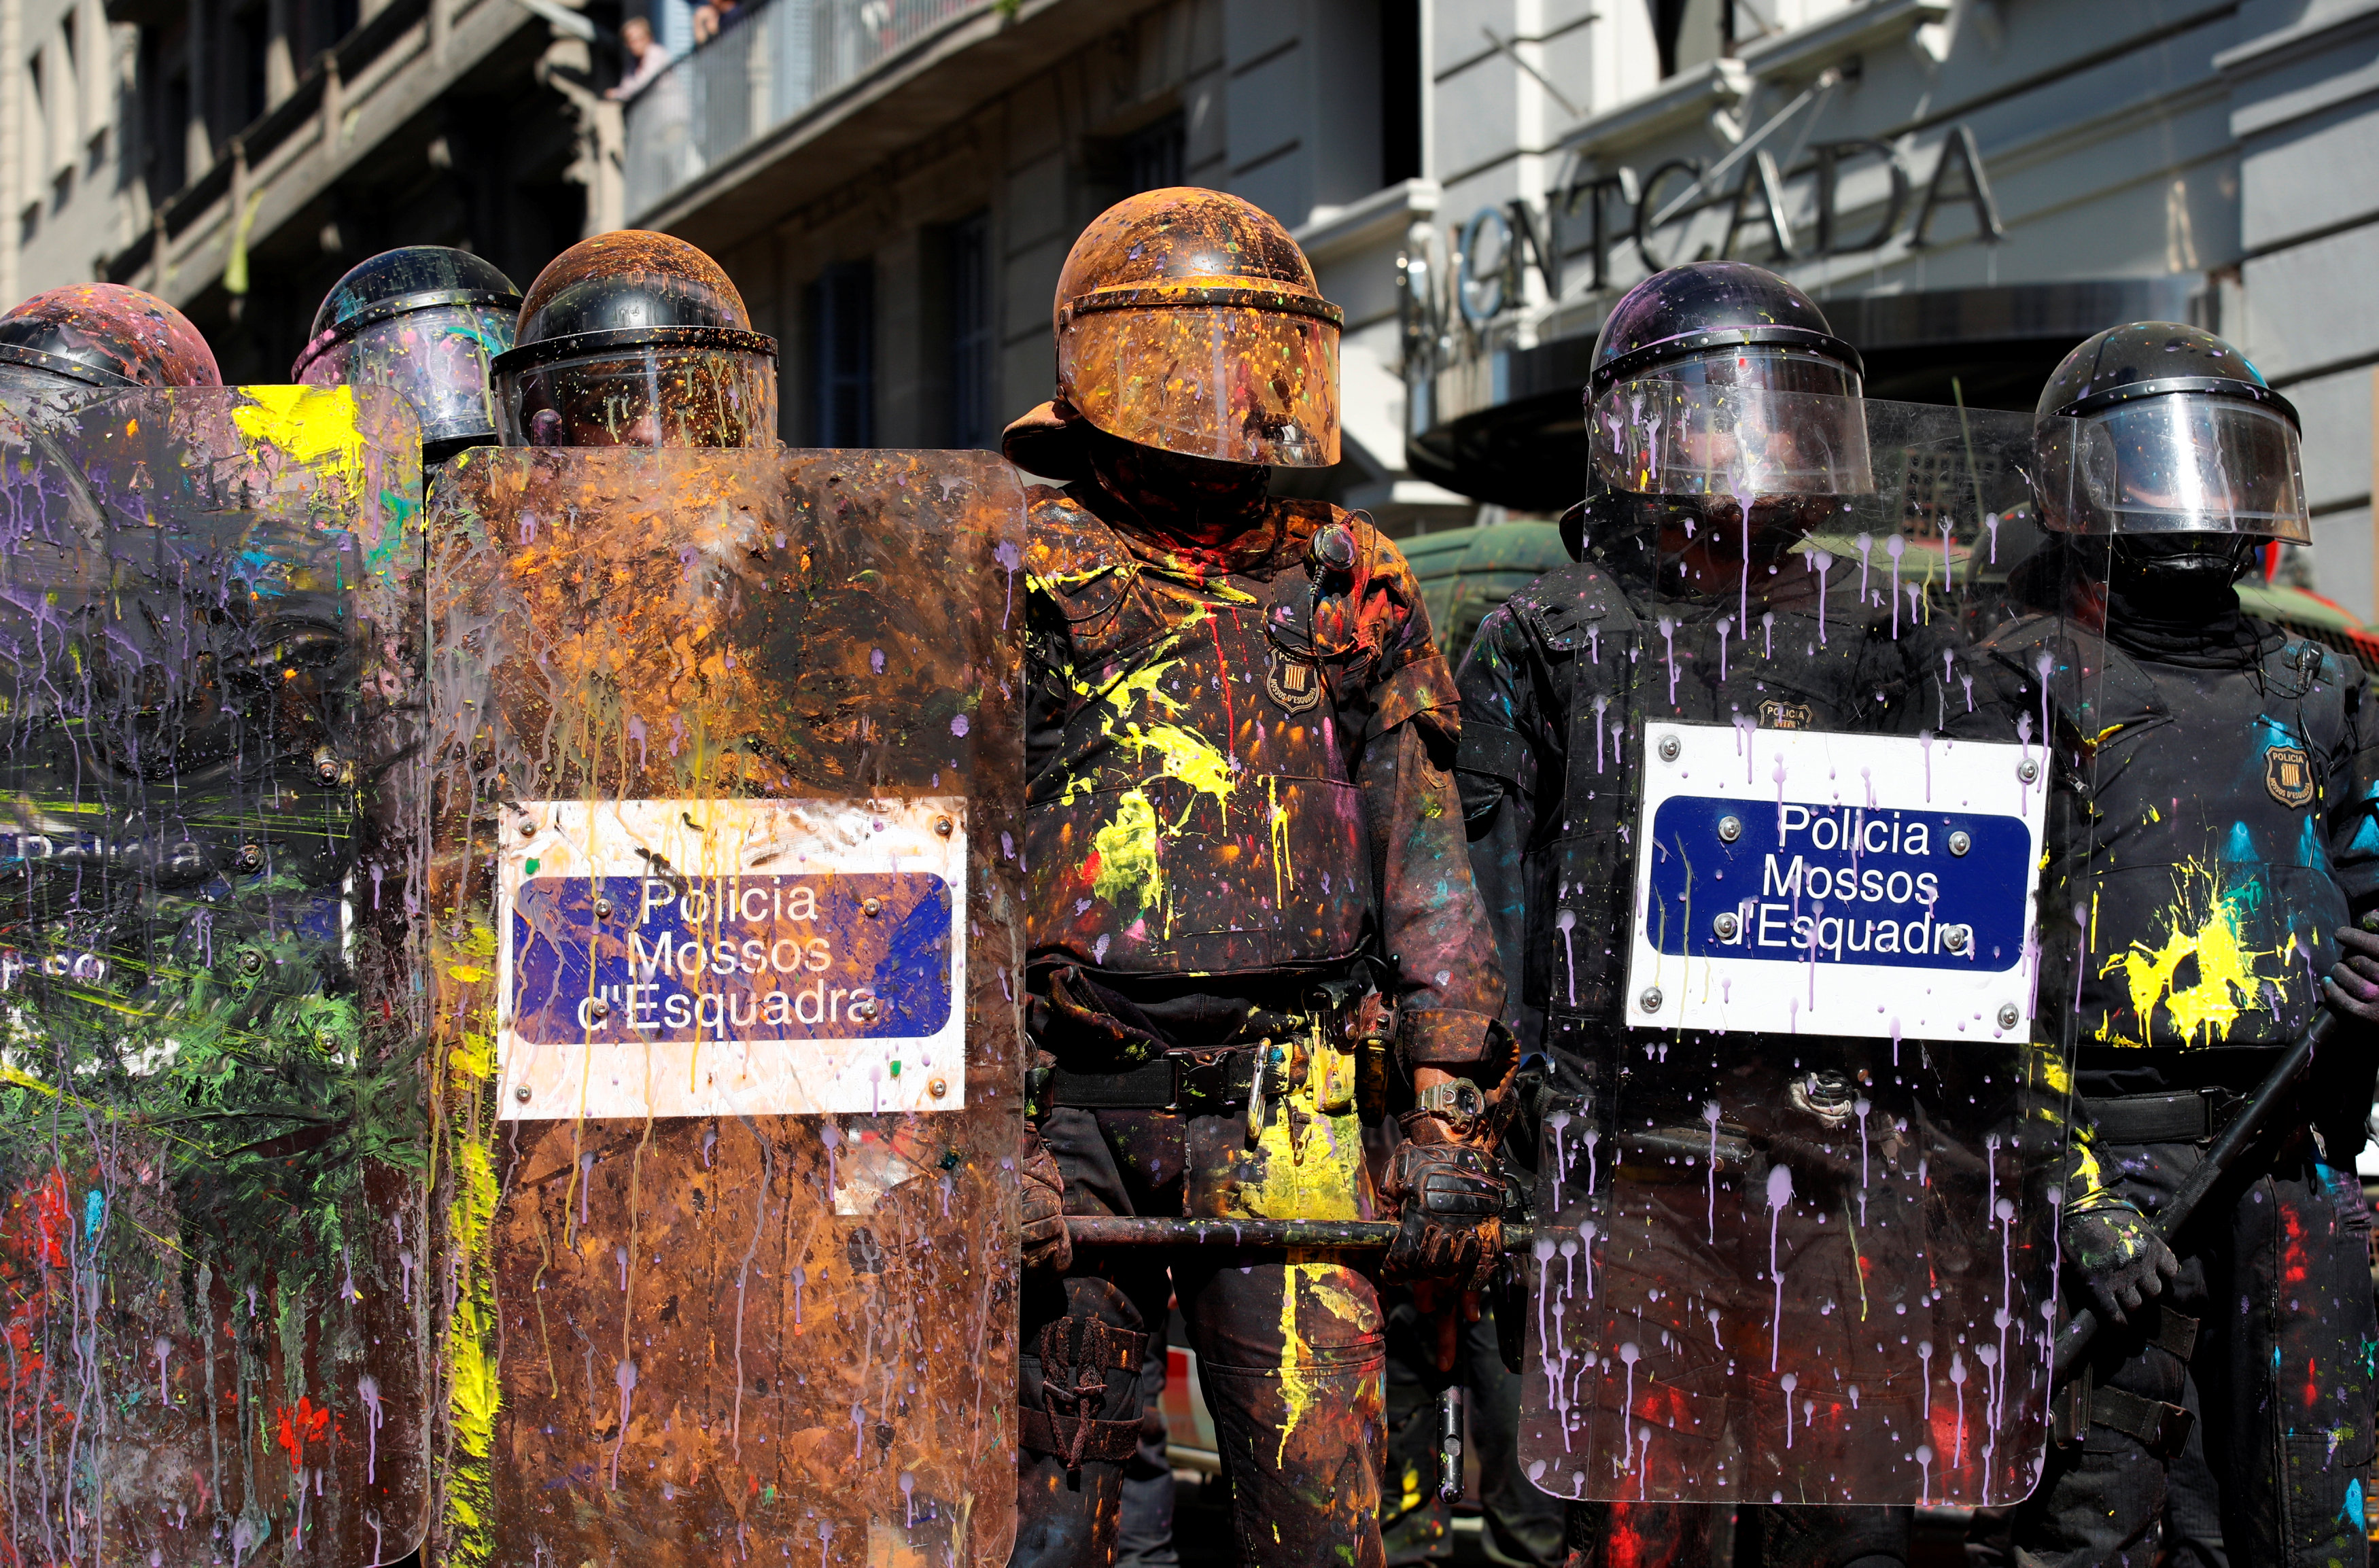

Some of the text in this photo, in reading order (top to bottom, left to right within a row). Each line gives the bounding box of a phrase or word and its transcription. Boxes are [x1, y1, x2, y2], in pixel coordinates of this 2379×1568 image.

[1270, 678, 1317, 704] MOSSOS D'ESQUADRA
[1767, 706, 1805, 720] POICIA
[2272, 752, 2304, 763] POLICIA
[1778, 805, 1930, 856] Policia
[642, 877, 818, 924] Policia
[1762, 853, 1939, 905] Mossos
[627, 930, 831, 977] Mossos
[1718, 902, 1975, 962] d'Esquadra
[578, 979, 880, 1039] d'Esquadra
